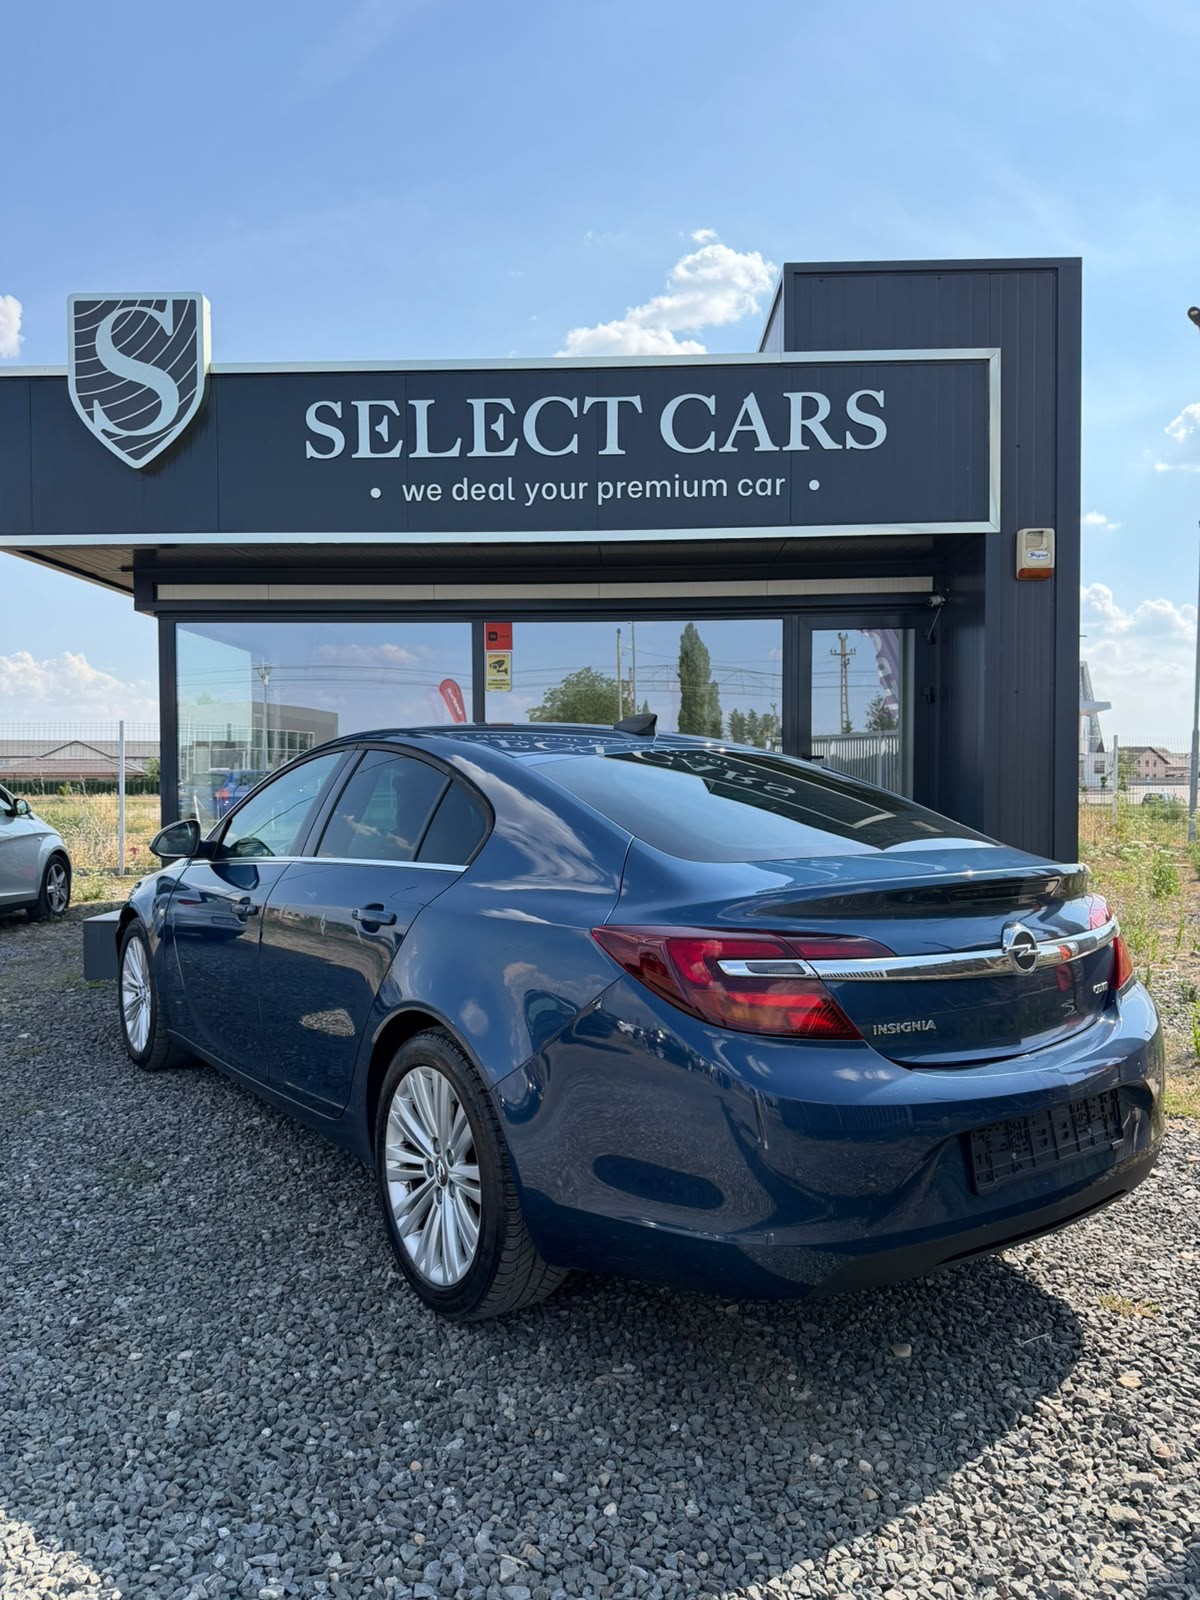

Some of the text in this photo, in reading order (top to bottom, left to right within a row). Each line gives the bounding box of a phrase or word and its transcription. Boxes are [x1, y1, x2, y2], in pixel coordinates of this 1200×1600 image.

[94, 299, 179, 436] S
[305, 389, 888, 460] SELECT CARS
[402, 473, 786, 507] we deal your premium car
[872, 1019, 937, 1036] INSIGNIA
